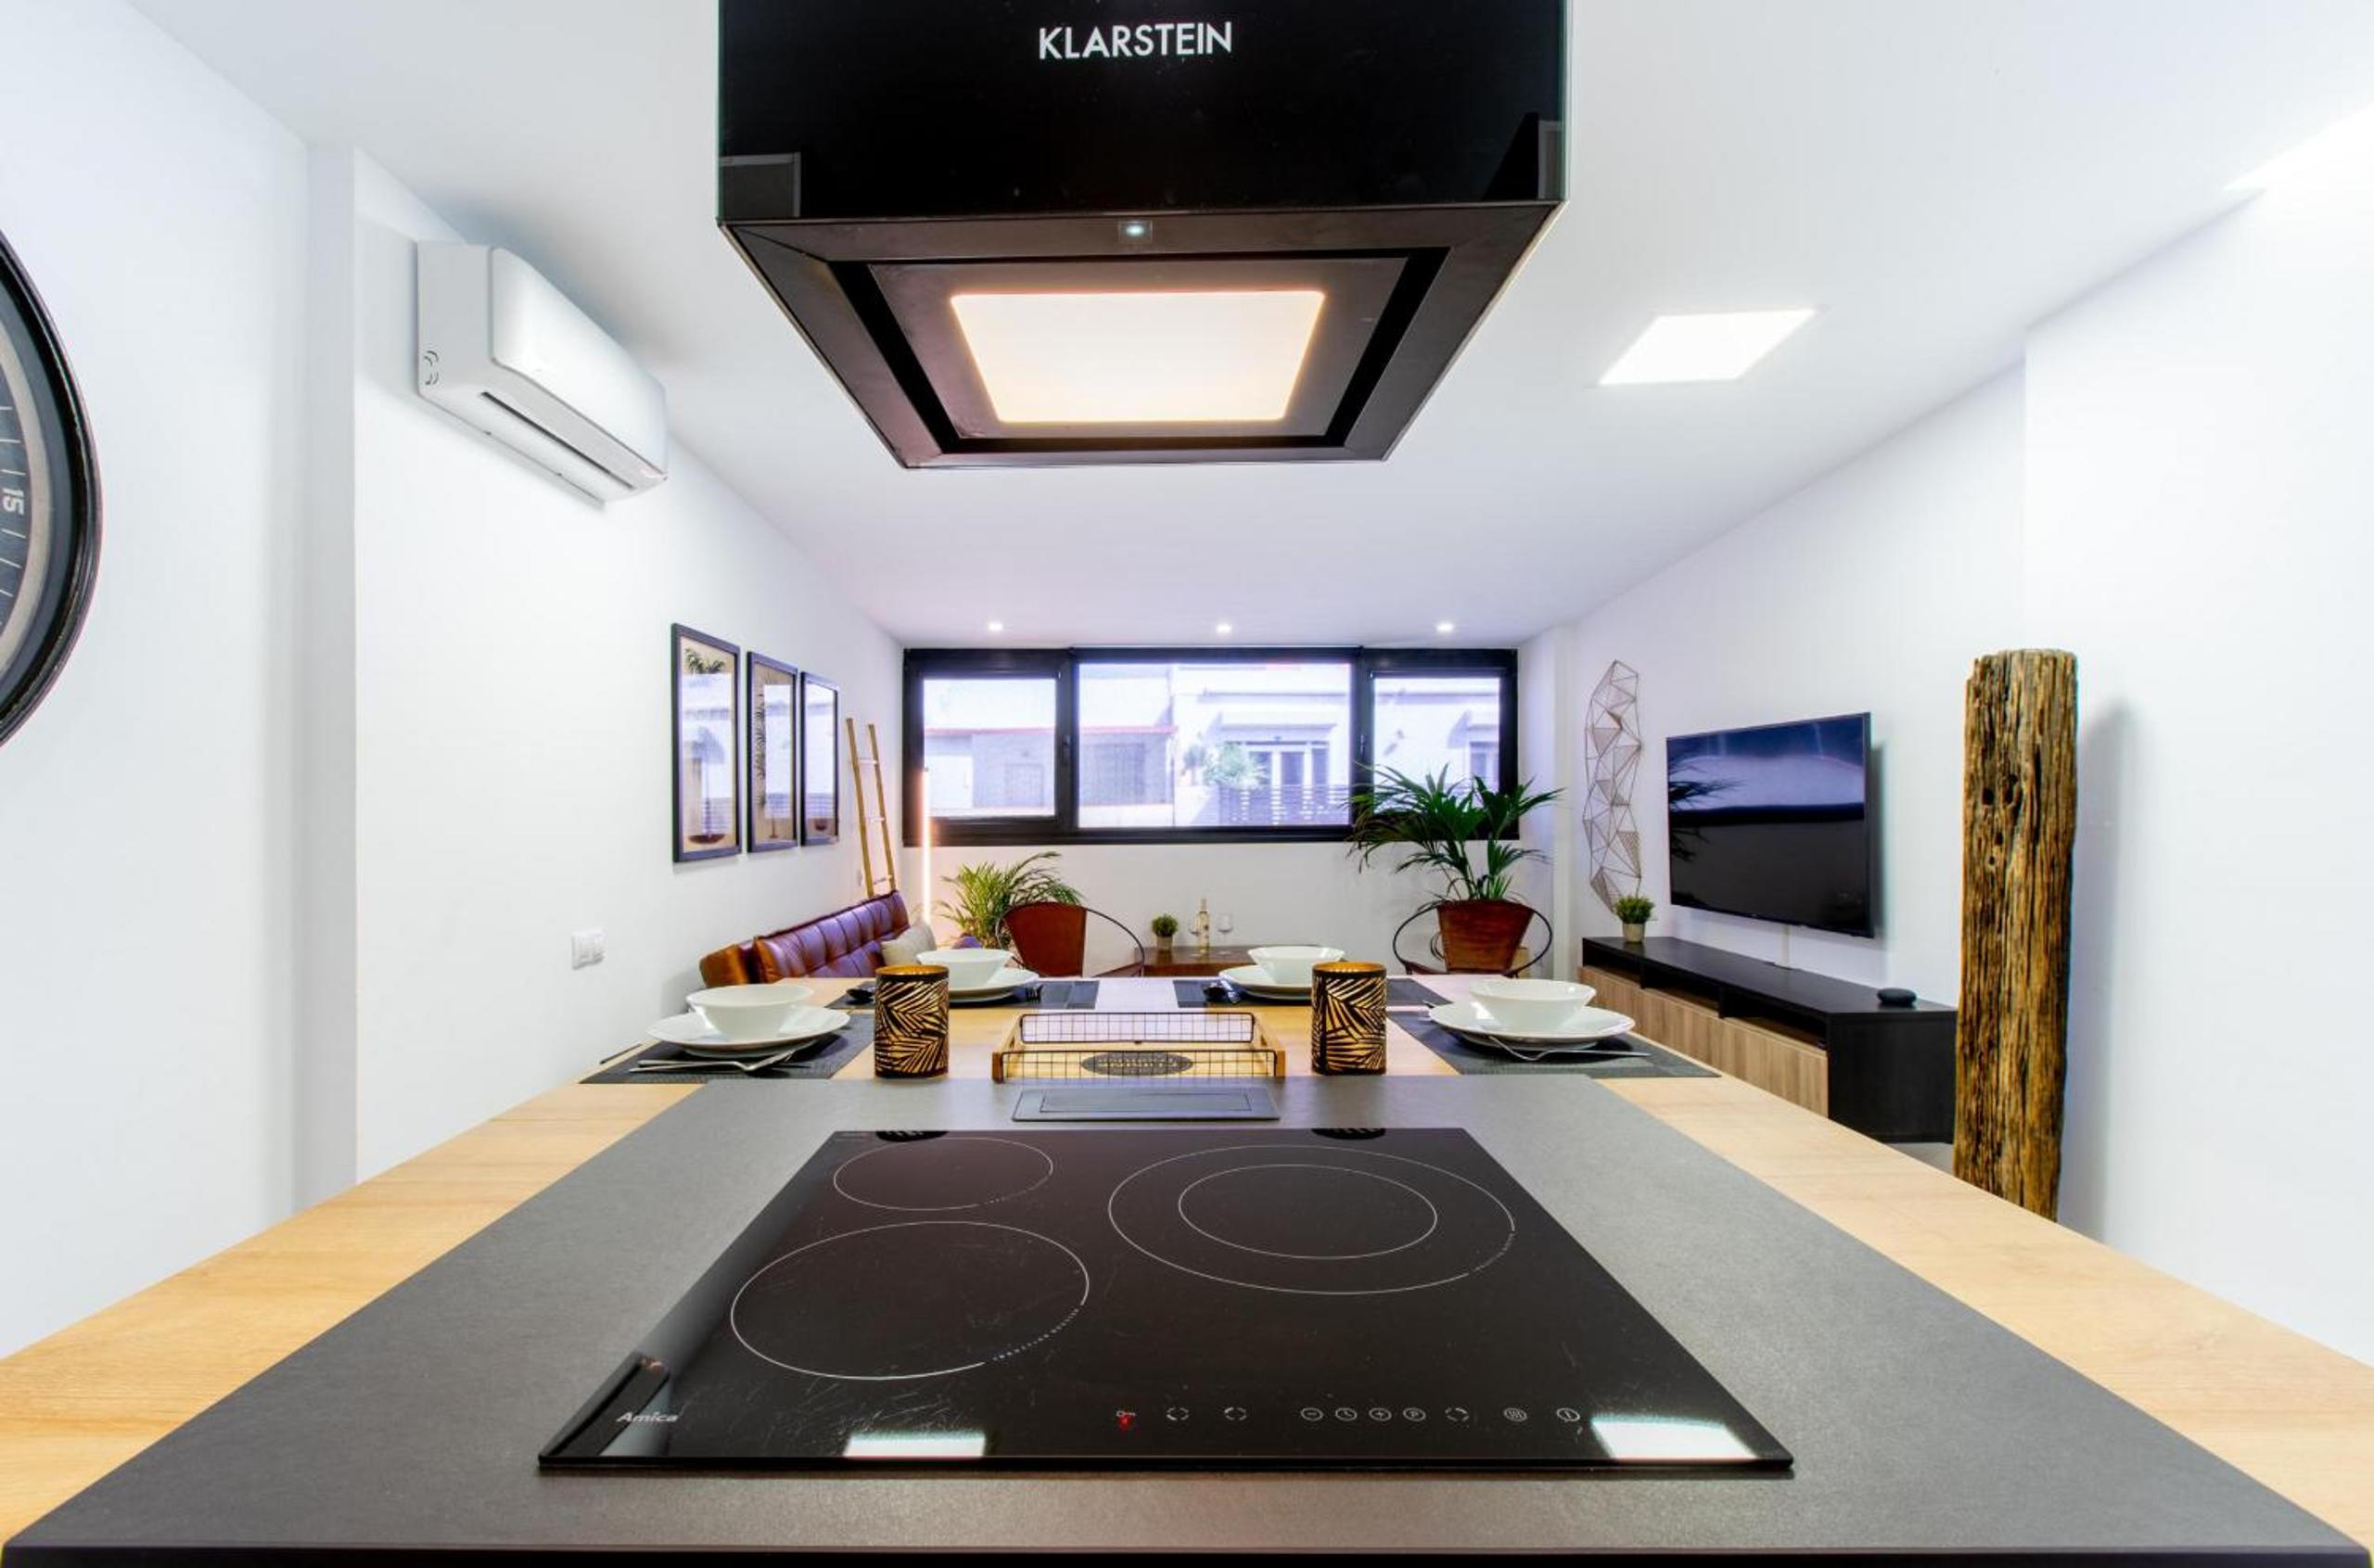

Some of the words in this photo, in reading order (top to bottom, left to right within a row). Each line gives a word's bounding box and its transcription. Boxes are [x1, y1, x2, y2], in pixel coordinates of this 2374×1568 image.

[1039, 21, 1232, 60] KLARSTEIN
[2, 488, 25, 516] 15
[616, 1411, 679, 1422] Amica
